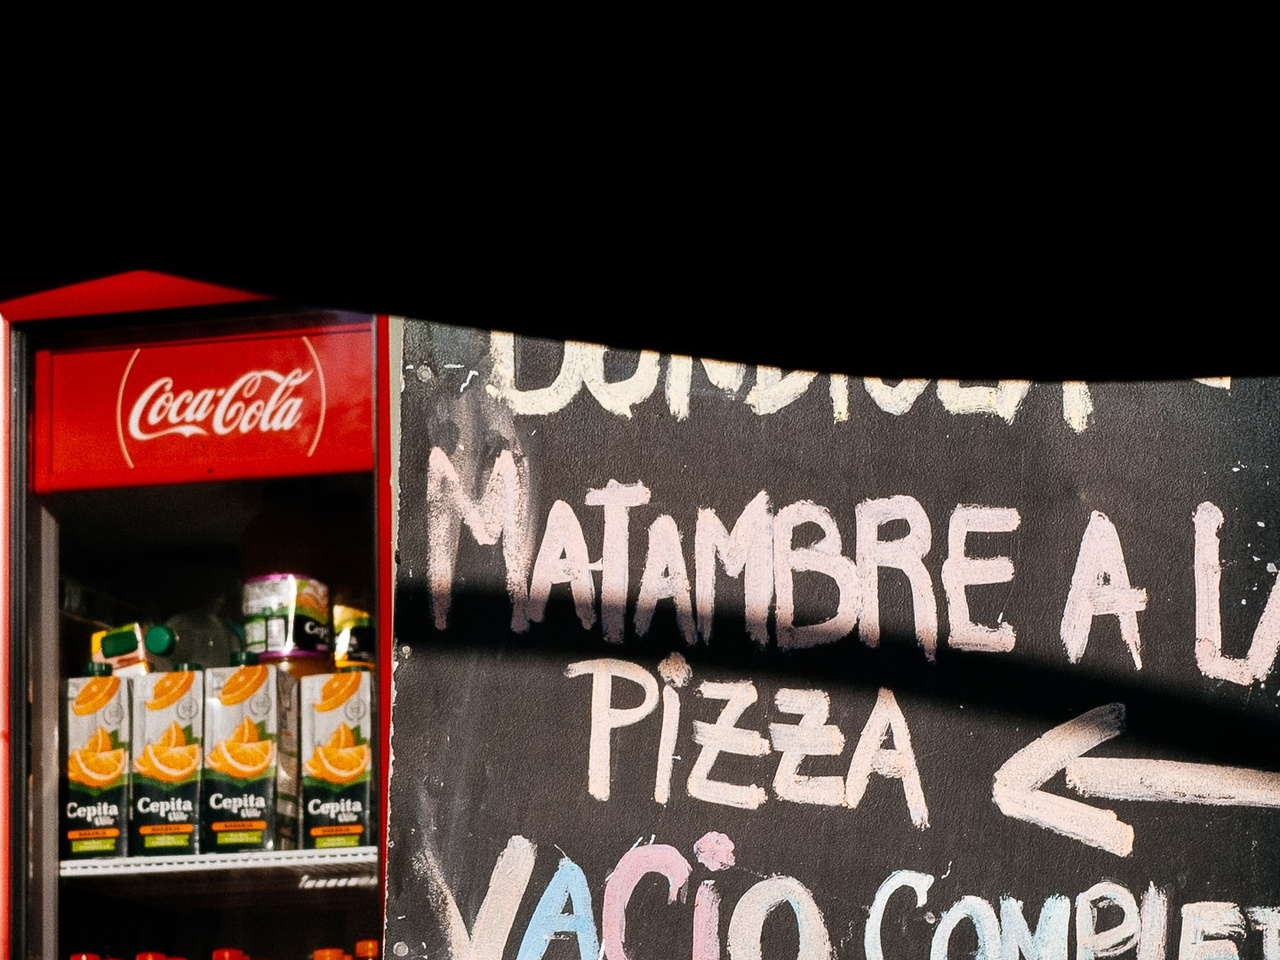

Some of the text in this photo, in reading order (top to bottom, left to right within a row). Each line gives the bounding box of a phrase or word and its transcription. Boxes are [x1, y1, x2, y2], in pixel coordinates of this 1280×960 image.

[128, 367, 315, 441] Coca-Cola
[426, 446, 1022, 664] MATAMBRE
[1059, 509, 1148, 671] A
[66, 801, 119, 822] Cepita
[136, 796, 193, 818] Cepita
[209, 792, 266, 814] Cepita
[307, 798, 363, 819] Cepita
